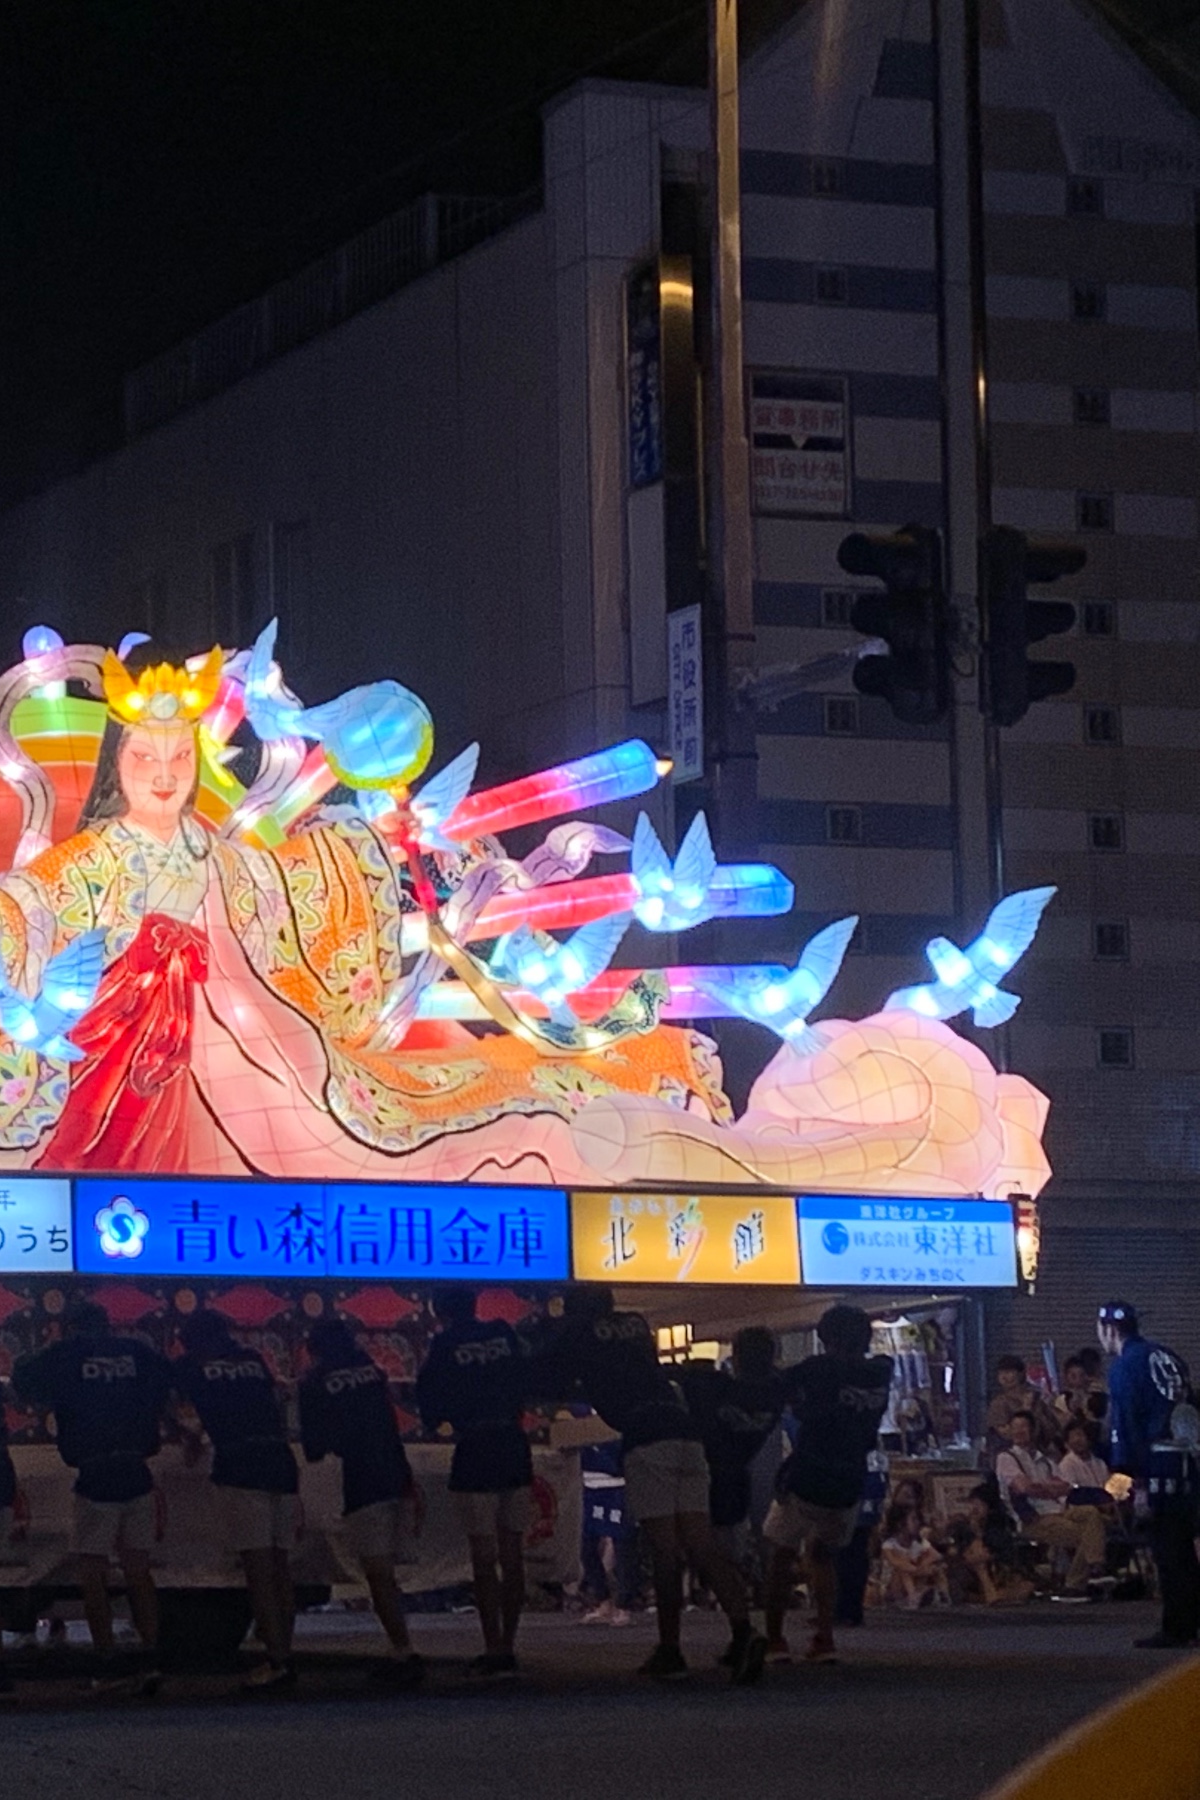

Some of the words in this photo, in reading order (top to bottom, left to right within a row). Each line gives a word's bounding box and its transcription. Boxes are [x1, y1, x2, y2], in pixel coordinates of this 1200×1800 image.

[168, 1200, 548, 1268] 青い森信用金庫
[860, 1266, 966, 1282] ダスキンみちのく
